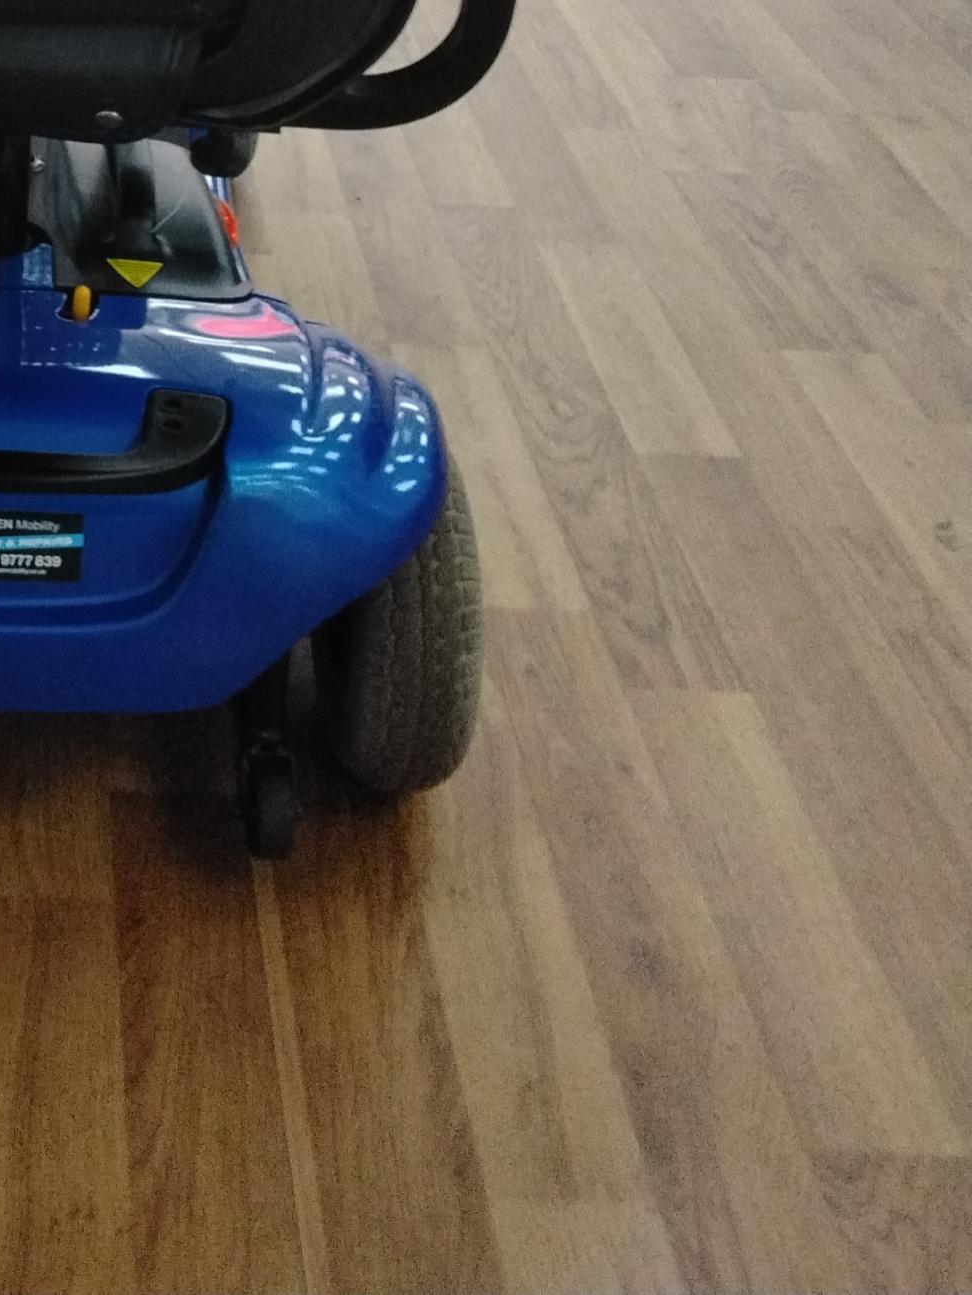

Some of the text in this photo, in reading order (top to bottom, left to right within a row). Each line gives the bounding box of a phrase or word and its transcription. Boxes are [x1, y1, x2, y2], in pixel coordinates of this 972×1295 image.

[16, 519, 60, 532] Mobility
[1, 553, 33, 566] 9777
[34, 555, 62, 568] 839
